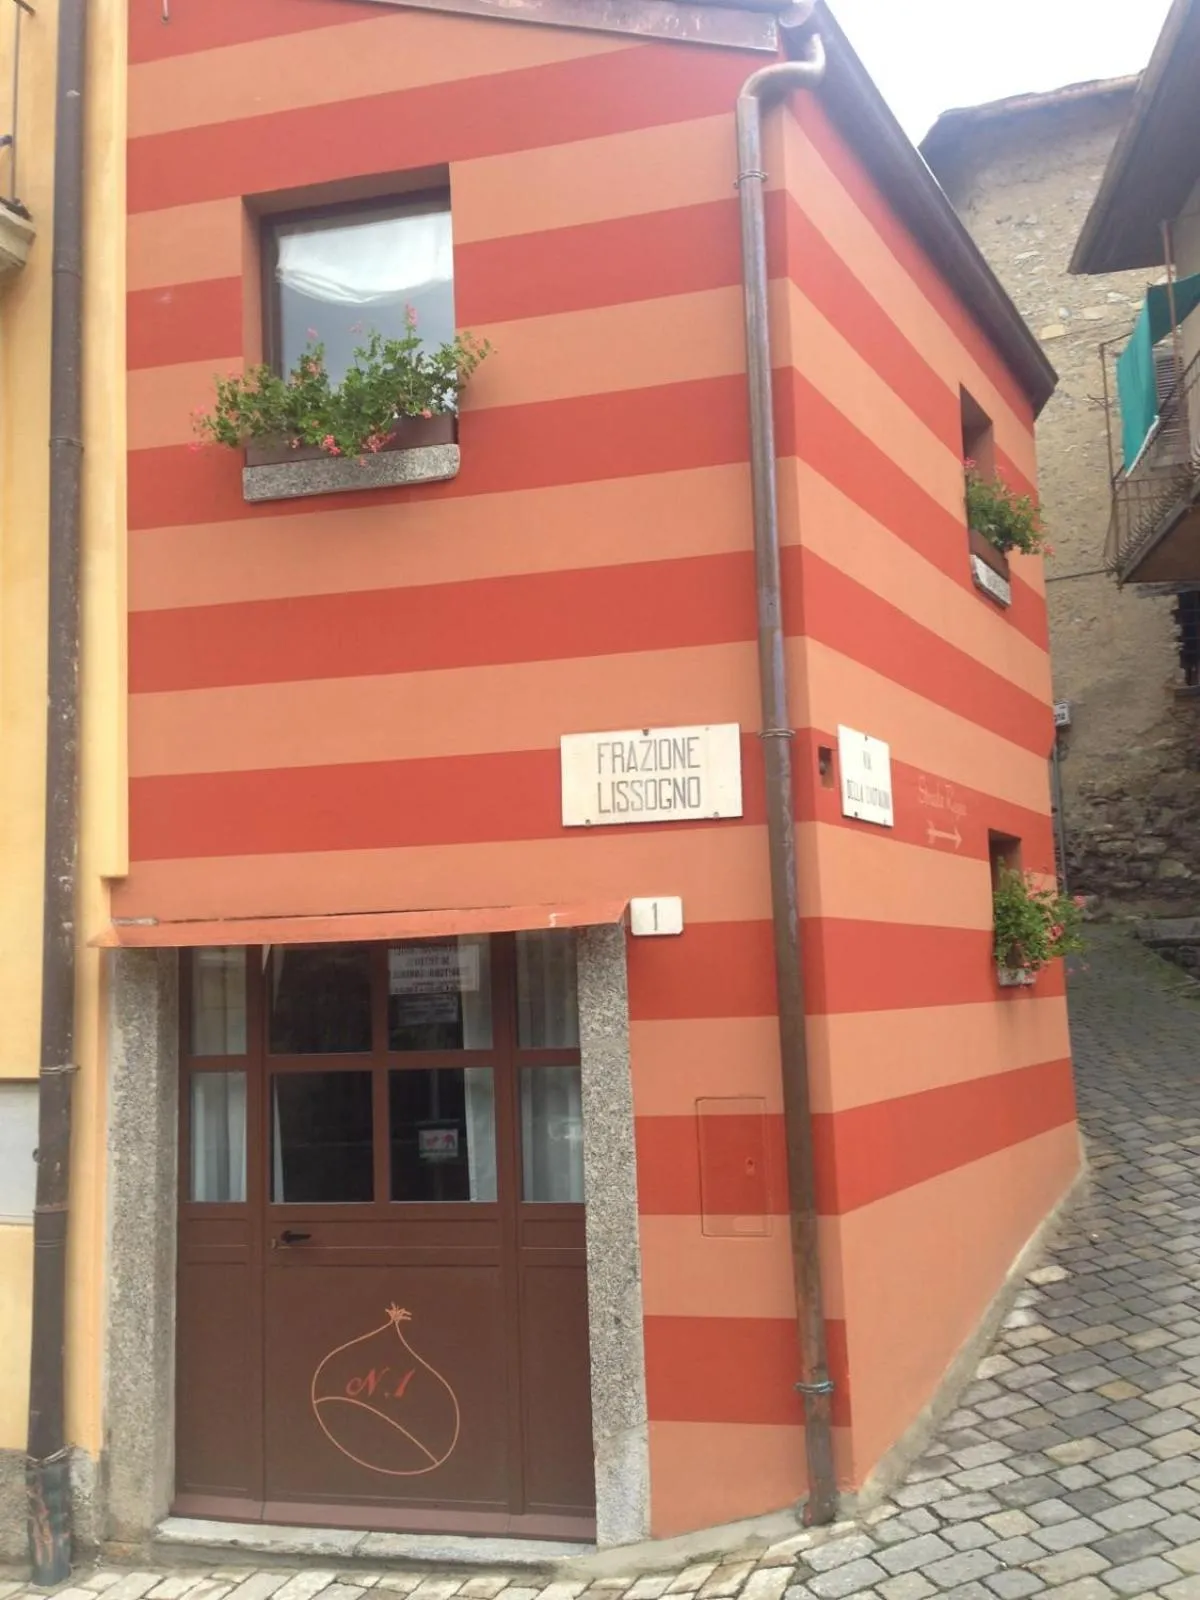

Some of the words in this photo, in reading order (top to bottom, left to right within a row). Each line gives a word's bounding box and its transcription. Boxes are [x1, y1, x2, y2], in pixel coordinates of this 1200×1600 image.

[597, 736, 701, 774] FRAZIONE
[597, 776, 701, 814] LISSOGNO
[651, 901, 659, 932] 1
